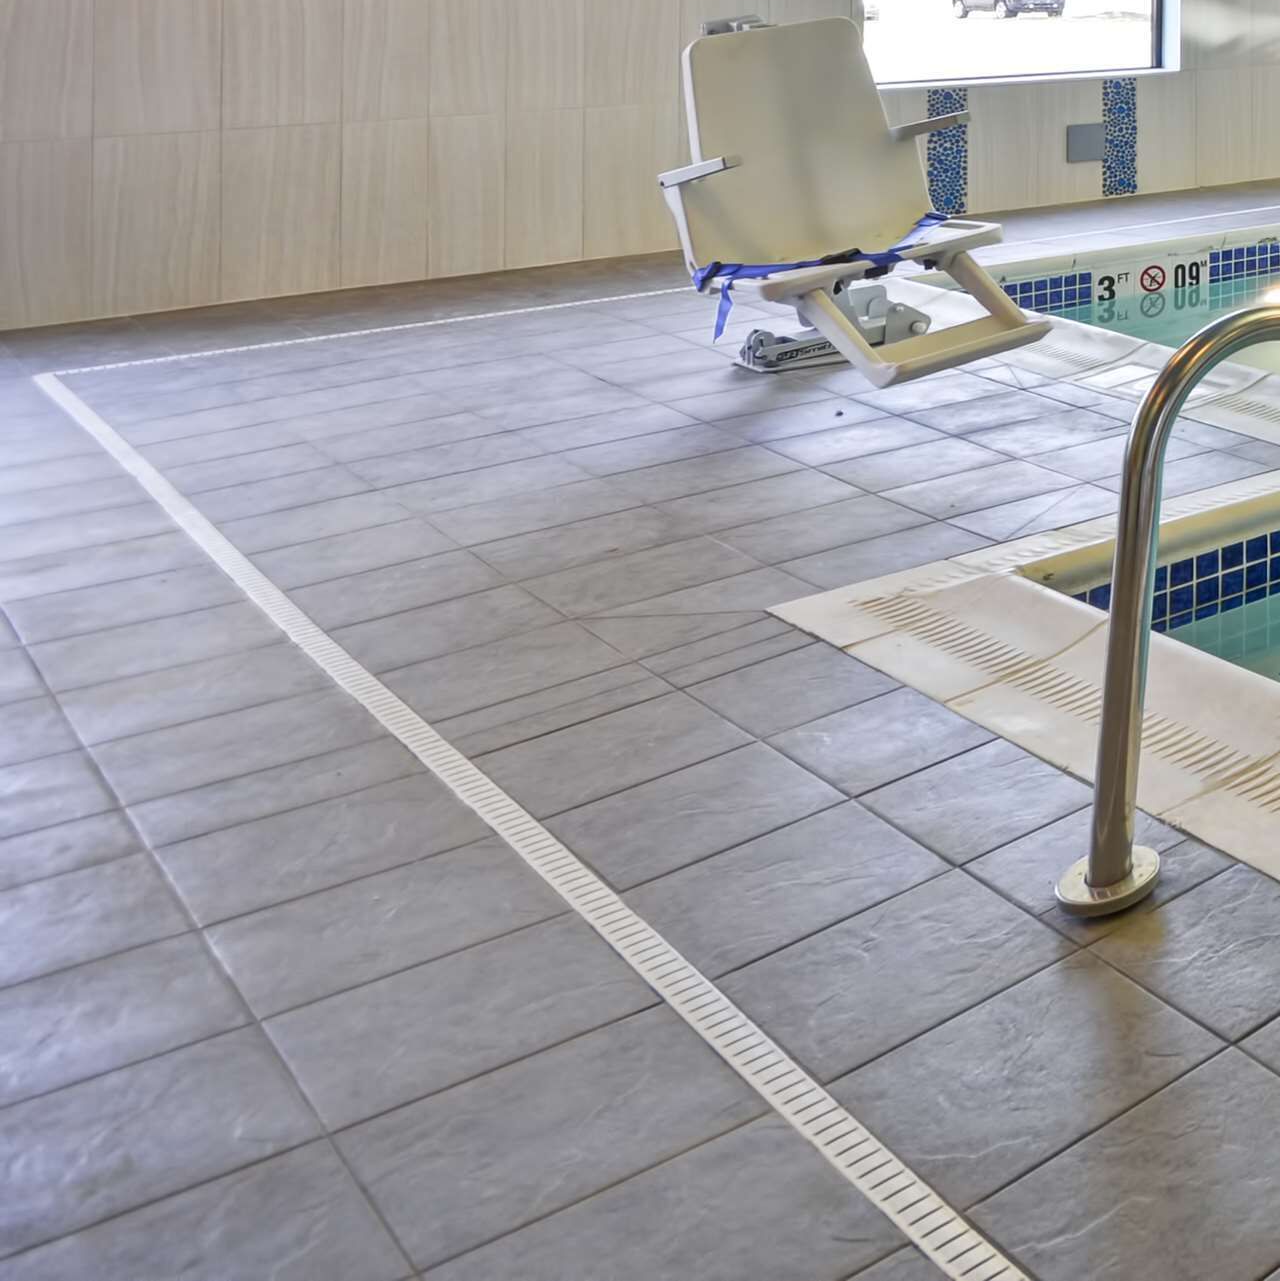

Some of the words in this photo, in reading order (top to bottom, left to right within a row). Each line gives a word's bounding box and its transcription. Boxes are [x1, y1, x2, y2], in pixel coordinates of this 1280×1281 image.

[1098, 276, 1115, 301] 3
[1117, 272, 1130, 283] FT
[1174, 262, 1200, 288] 09
